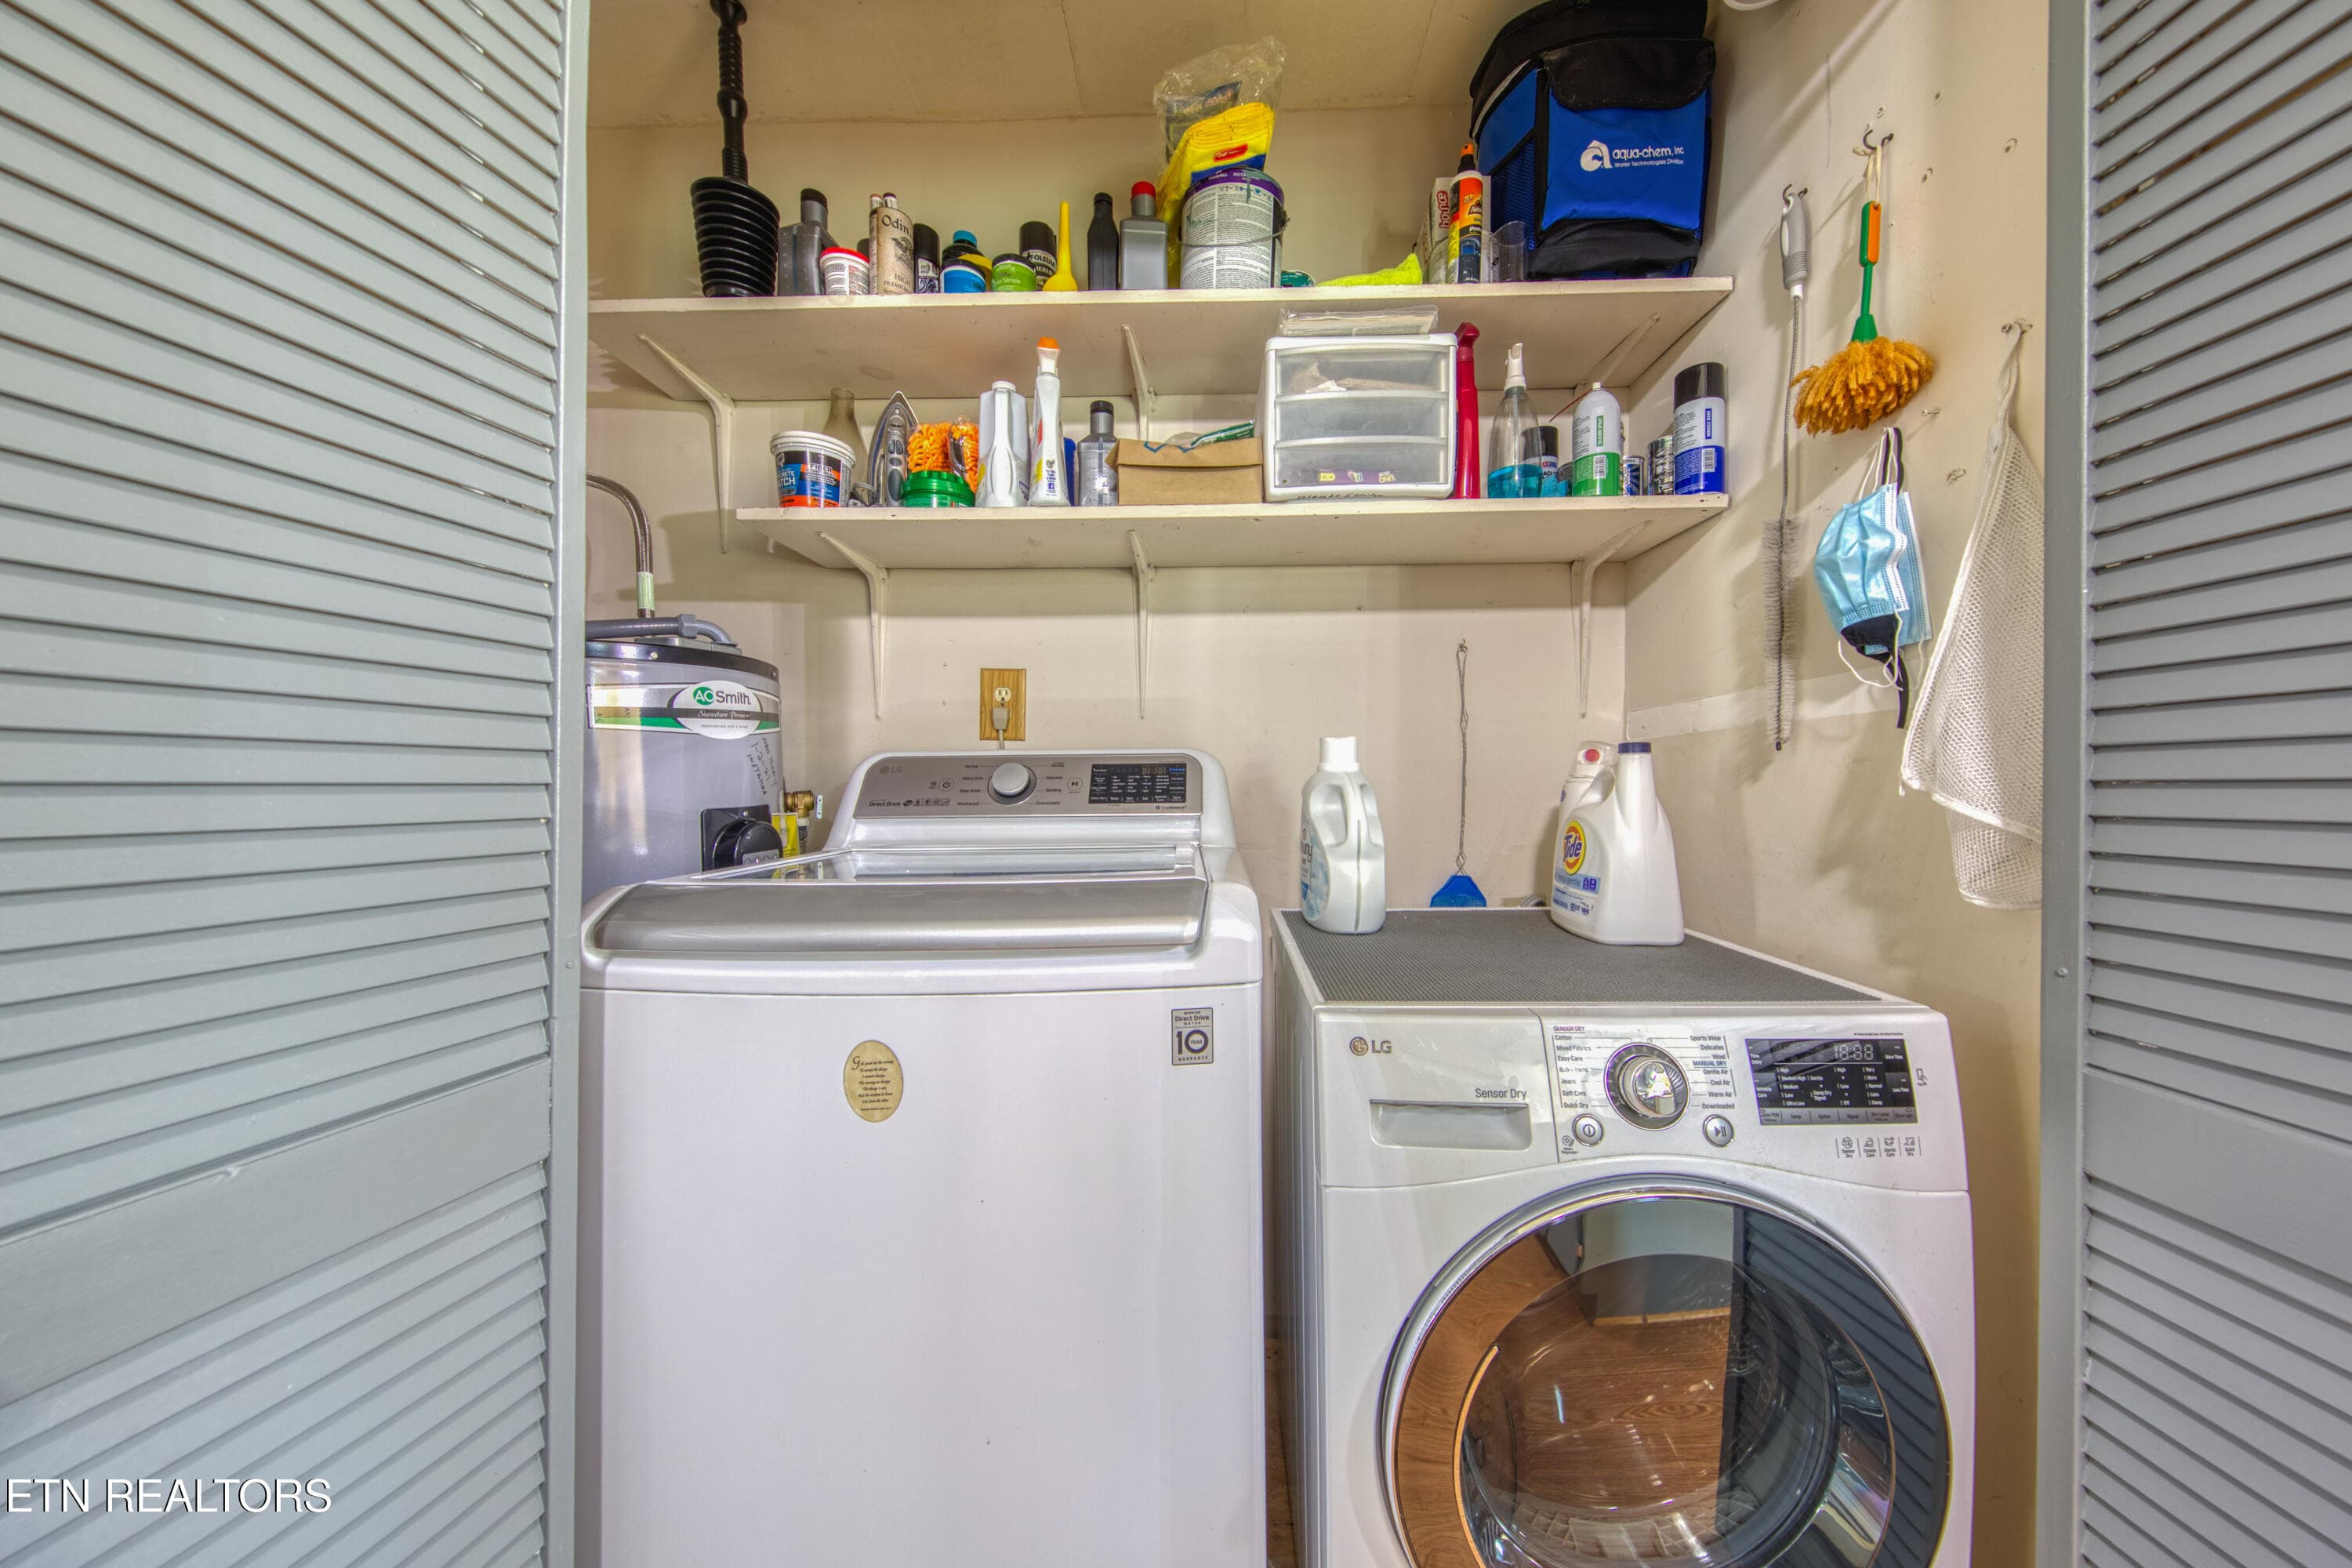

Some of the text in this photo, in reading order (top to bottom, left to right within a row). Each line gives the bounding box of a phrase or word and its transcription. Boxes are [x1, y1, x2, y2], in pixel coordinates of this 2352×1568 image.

[715, 691, 750, 705] Smith
[698, 710, 728, 718] Signature
[1563, 833, 1583, 862] Tide
[1176, 1029, 1209, 1054] 10
[1371, 1040, 1392, 1054] LG
[1475, 1088, 1526, 1101] Sensor Dry
